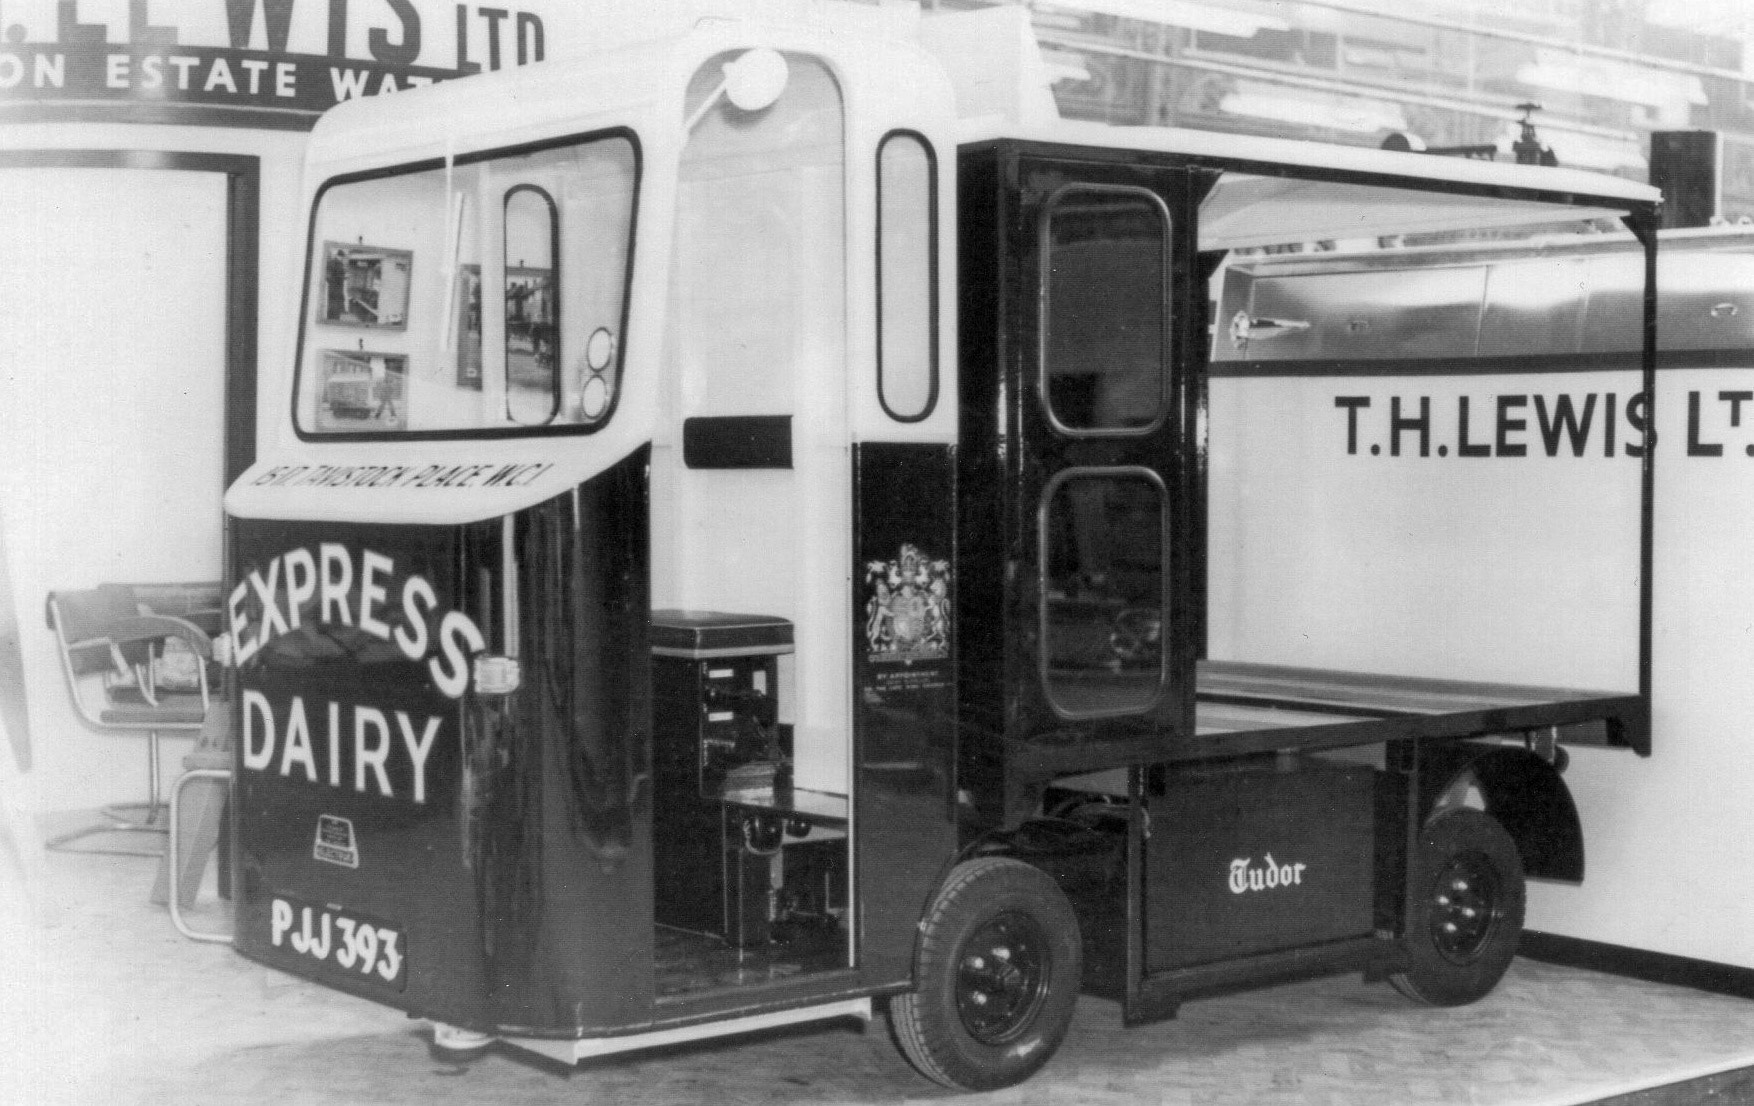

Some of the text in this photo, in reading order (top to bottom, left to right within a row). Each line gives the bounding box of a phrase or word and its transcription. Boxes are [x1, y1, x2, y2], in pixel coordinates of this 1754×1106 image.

[106, 53, 296, 97] ESTATE
[228, 542, 485, 698] EXPRESS
[243, 689, 442, 803] DAIRY
[1228, 851, 1307, 894] Tudor
